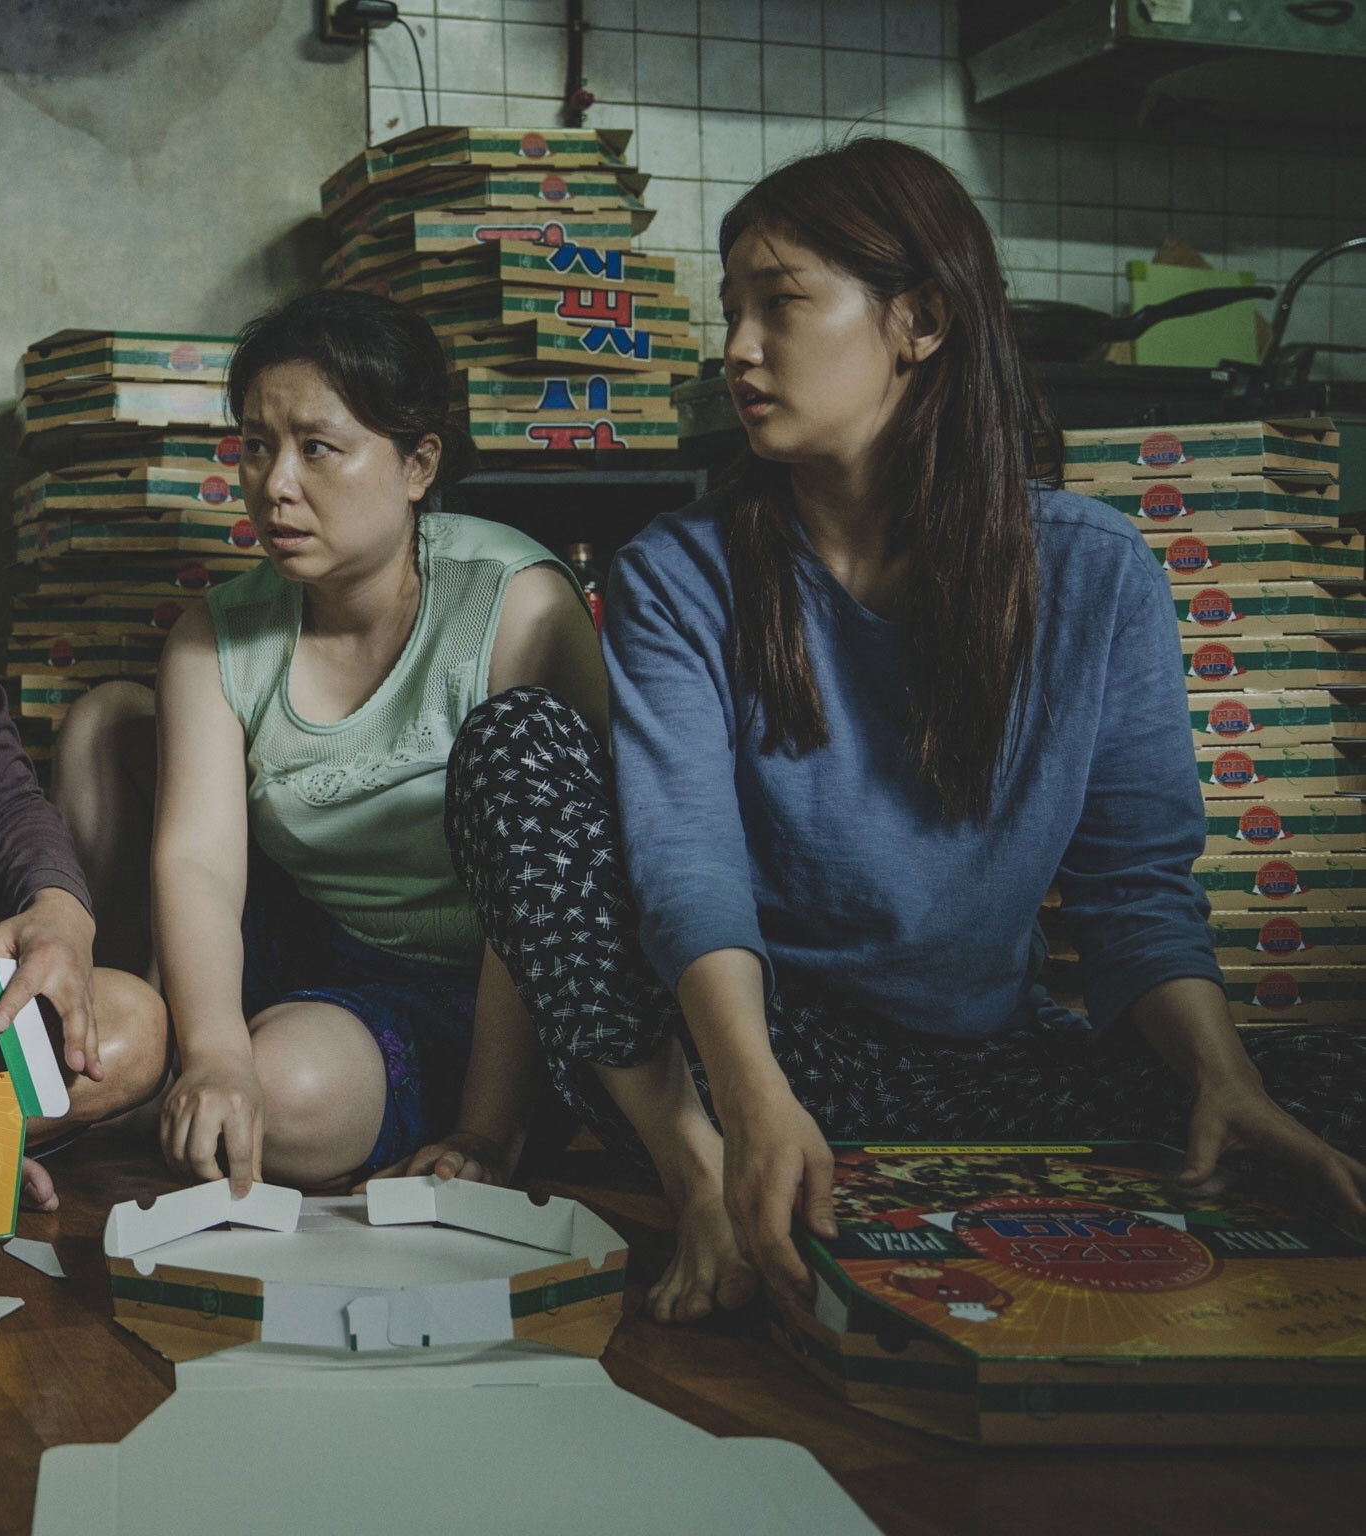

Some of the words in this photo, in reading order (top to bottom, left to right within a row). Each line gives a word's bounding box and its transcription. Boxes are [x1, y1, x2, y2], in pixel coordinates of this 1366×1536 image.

[982, 1218, 1136, 1238] 시대
[856, 1232, 948, 1251] PIZZA
[1213, 1231, 1311, 1250] ITALY
[1009, 1242, 1187, 1264] 피자
